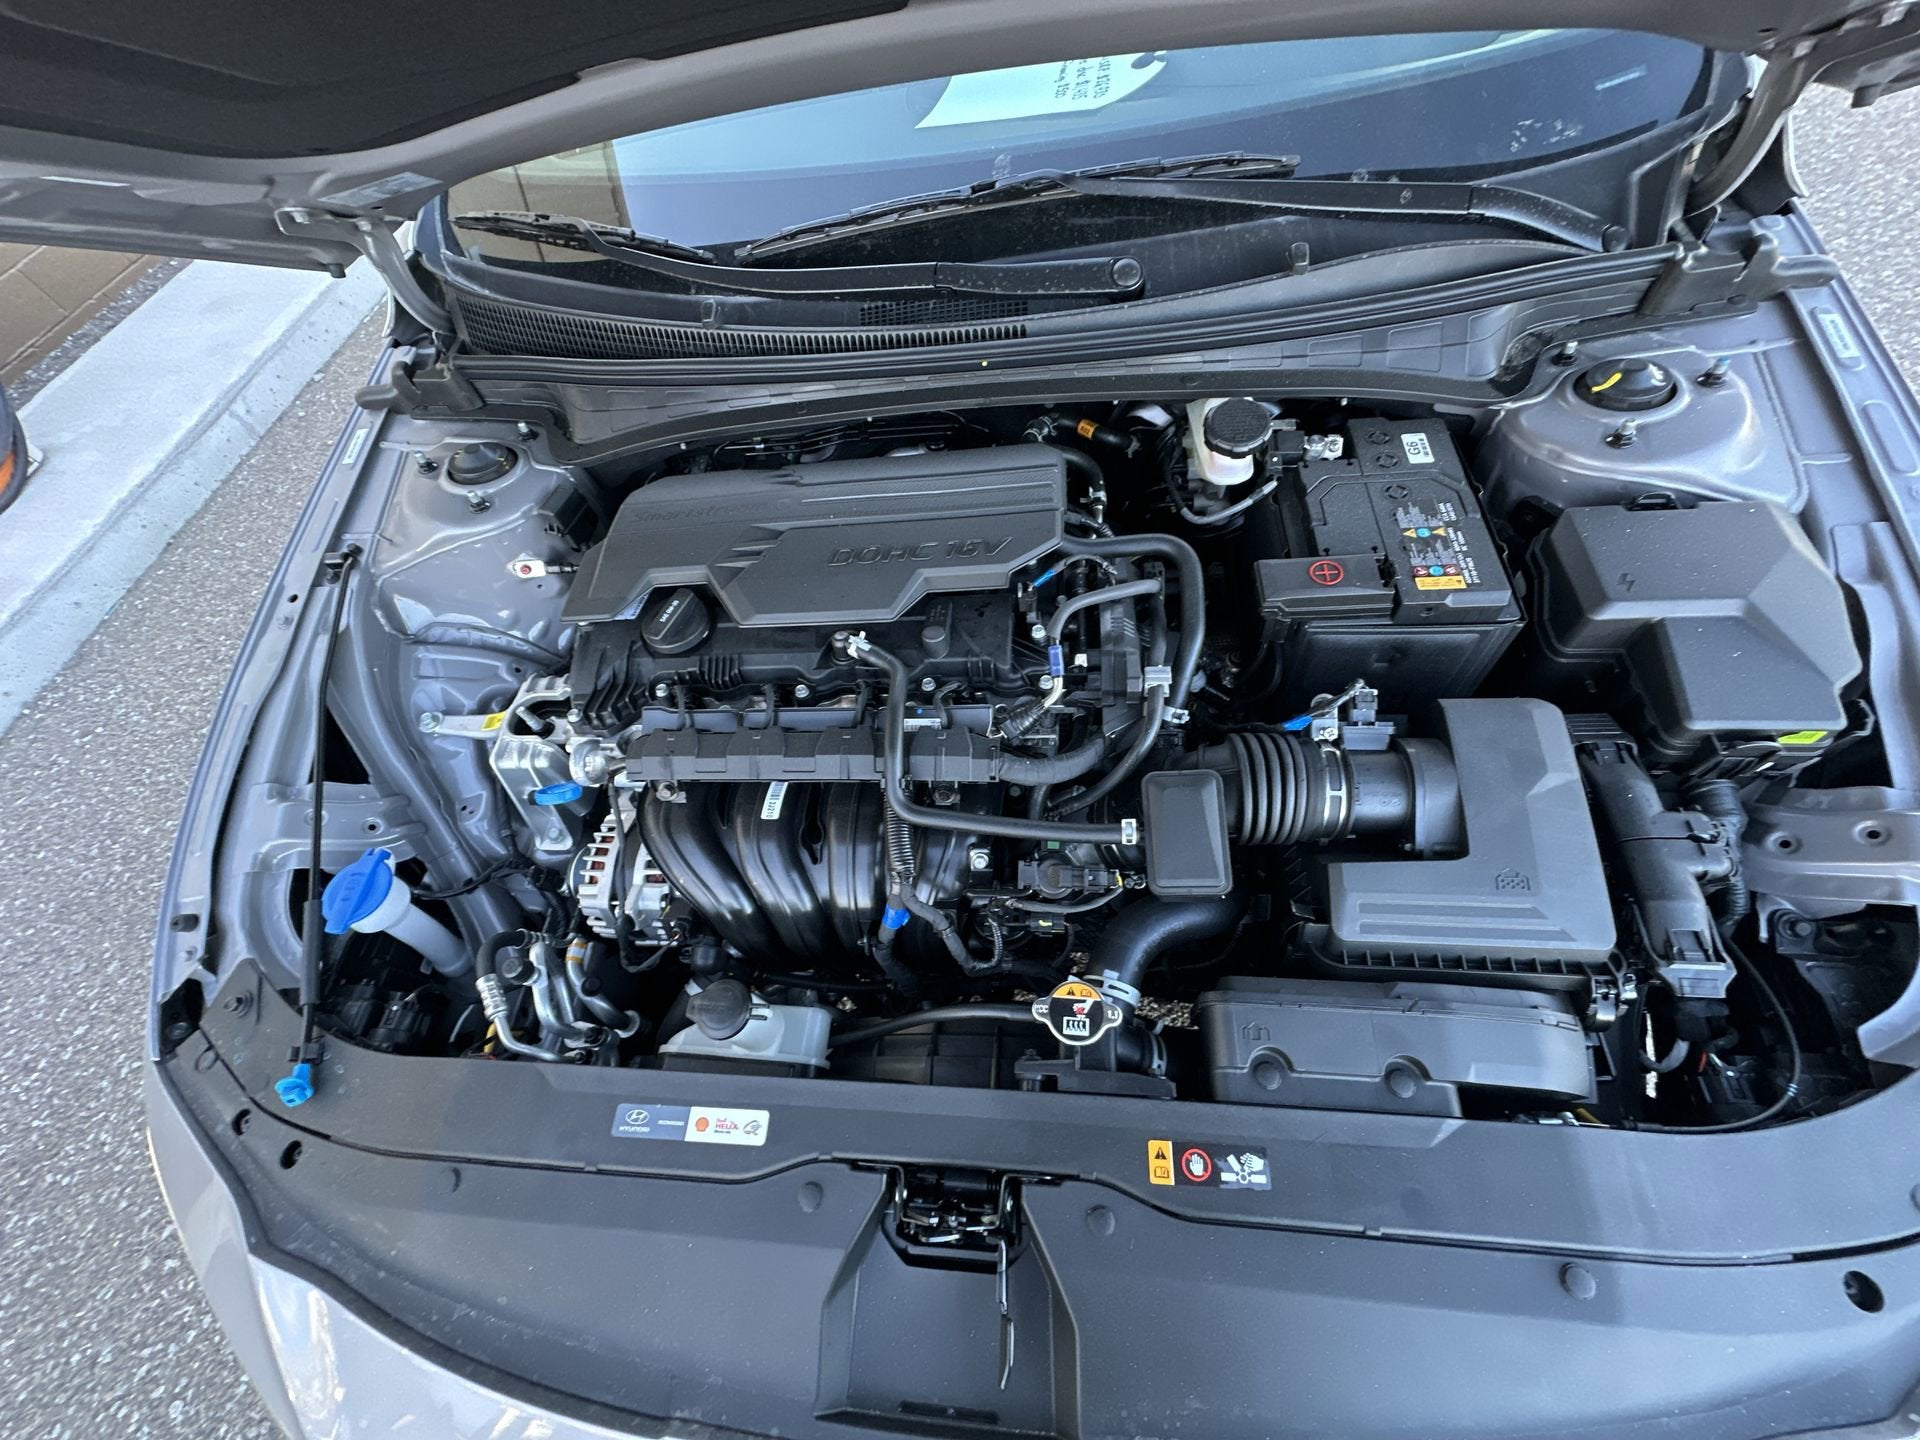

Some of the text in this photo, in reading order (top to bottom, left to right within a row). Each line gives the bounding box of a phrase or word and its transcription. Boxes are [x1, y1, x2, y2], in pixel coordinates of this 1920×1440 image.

[1406, 441, 1421, 456] G6
[827, 536, 1014, 567] DOHC 16V
[618, 1125, 651, 1133] HYUNDAI
[716, 1121, 739, 1130] HELIX
